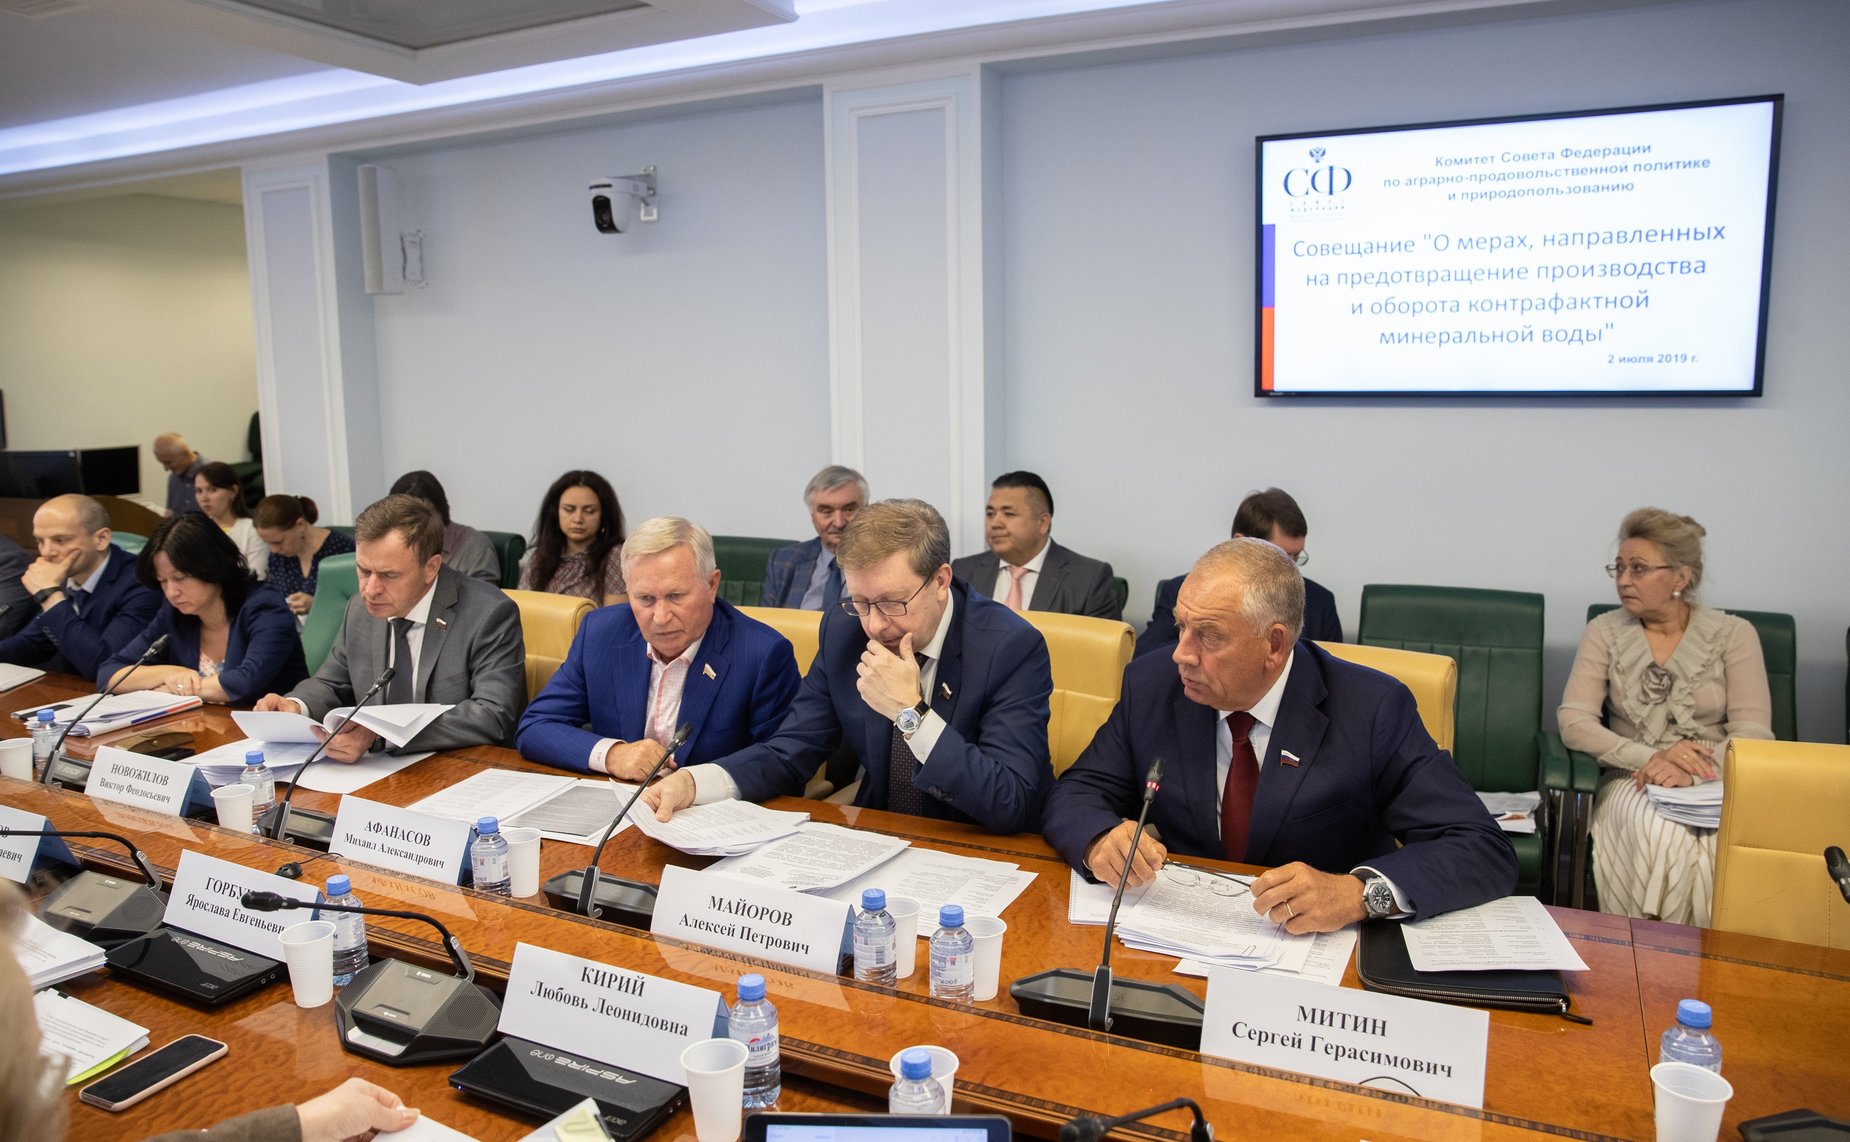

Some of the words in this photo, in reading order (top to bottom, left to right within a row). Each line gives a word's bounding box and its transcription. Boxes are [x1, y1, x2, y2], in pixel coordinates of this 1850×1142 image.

[1435, 153, 1496, 168] Комитет
[1501, 150, 1556, 164] Совета
[1560, 143, 1652, 160] Федерации
[1383, 177, 1400, 188] по
[1405, 162, 1629, 187] аграрно-продовольственной
[1633, 157, 1711, 173] политике
[1448, 192, 1457, 201] и
[1461, 181, 1635, 202] природопользованию
[1293, 239, 1416, 258] Совещание
[1423, 233, 1450, 252] "О
[1457, 234, 1534, 253] мерах,
[1543, 224, 1726, 250] направленных
[1306, 273, 1330, 286] на
[1337, 265, 1529, 288] предотвращение
[1537, 259, 1707, 282] производства
[1351, 302, 1363, 315] и
[1370, 296, 1460, 317] оборота
[1469, 289, 1650, 315] контрафактной
[1379, 324, 1534, 348] минеральной
[1542, 322, 1615, 345] воды"
[1608, 354, 1615, 364] 2
[1619, 355, 1654, 364] июля
[1657, 353, 1688, 364] 2019
[1691, 354, 1699, 364] г.
[99, 777, 125, 794] Виктор
[111, 763, 170, 786] НОВОЖИЛОВ
[364, 820, 432, 847] АФАНАСОВ
[343, 832, 377, 851] Михаил
[378, 842, 445, 869] Александрович
[186, 893, 231, 918] Ярослава
[708, 895, 794, 927] МАЙОРОВ
[679, 913, 736, 938] Алексей
[740, 926, 810, 955] Петрович
[187, 941, 244, 962] ASPIRE
[580, 966, 646, 997] КИРИЙ
[530, 980, 589, 1010] Любовь
[592, 997, 689, 1037] Леонидовна
[1297, 1004, 1389, 1038] МИТИН
[1231, 1020, 1303, 1051] Сергей
[1310, 1034, 1453, 1079] Герасимович
[554, 1056, 637, 1085] ASPIRE
